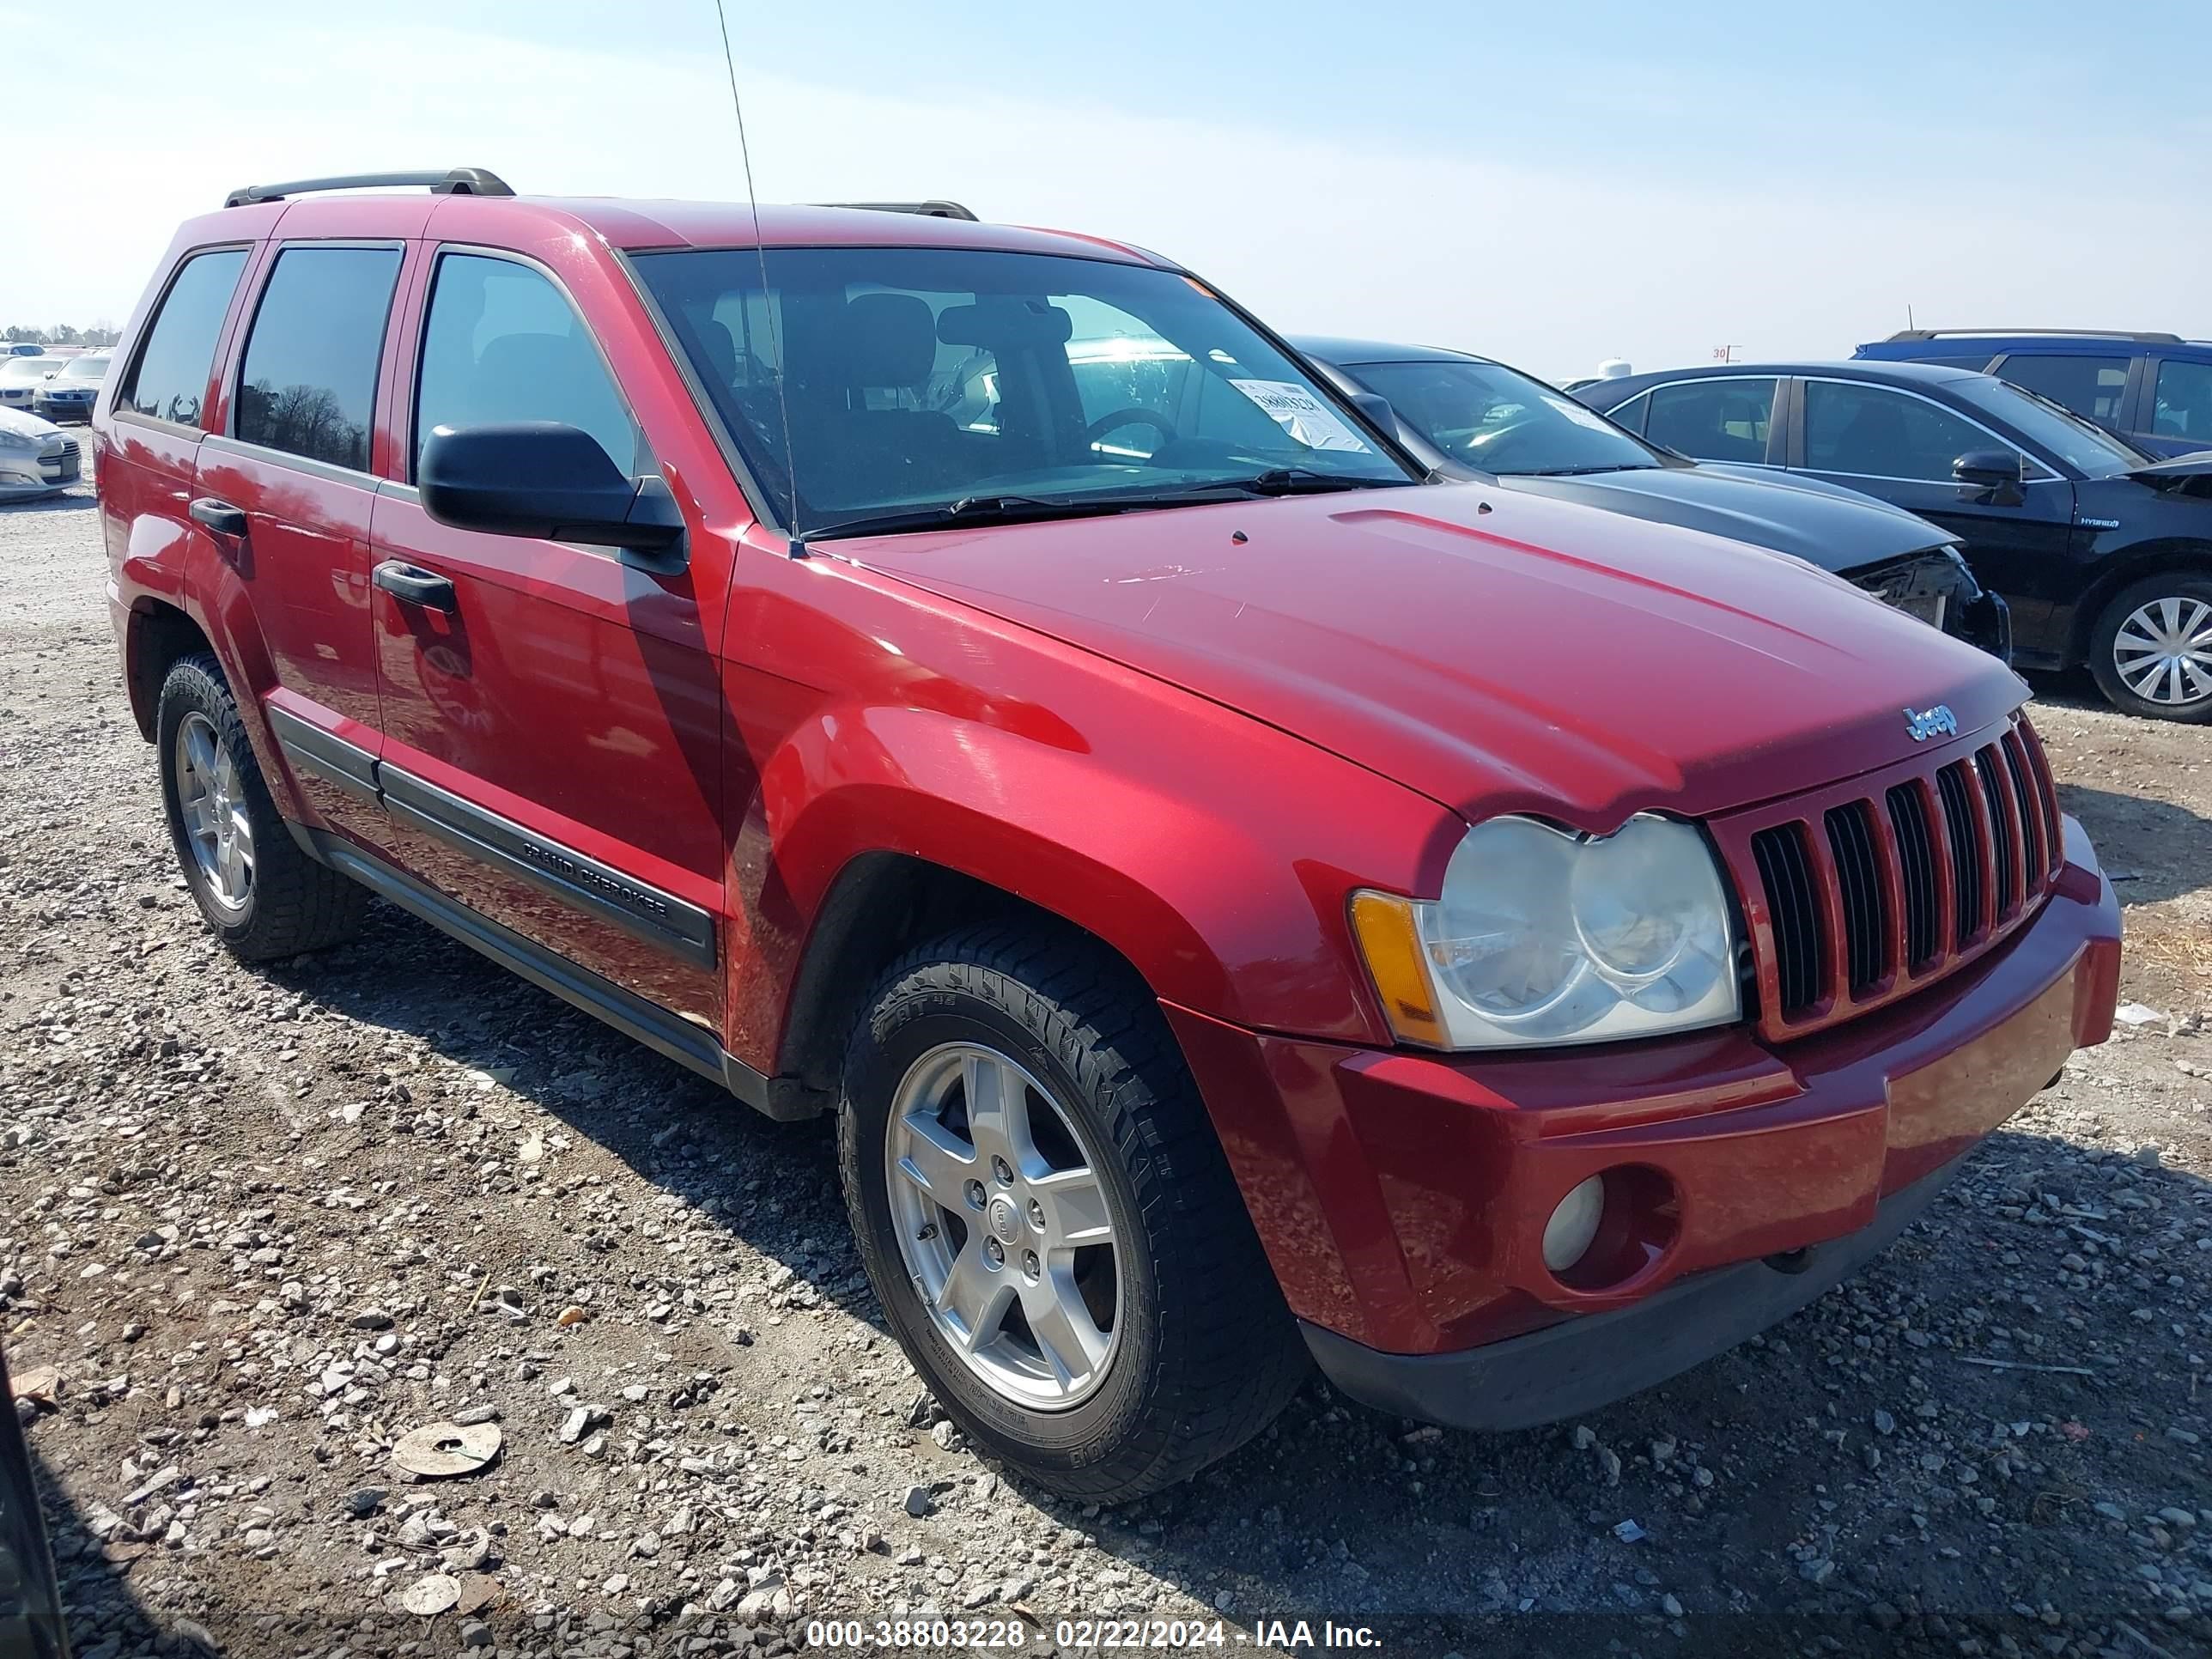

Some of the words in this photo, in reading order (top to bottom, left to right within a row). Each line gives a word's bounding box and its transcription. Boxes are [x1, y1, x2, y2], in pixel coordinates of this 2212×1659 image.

[1713, 349, 1726, 358] 30
[2081, 517, 2119, 528] HYBRID
[1902, 705, 1958, 742] Jeep
[522, 842, 576, 877] GRAND
[580, 868, 668, 919] CHEROKEE
